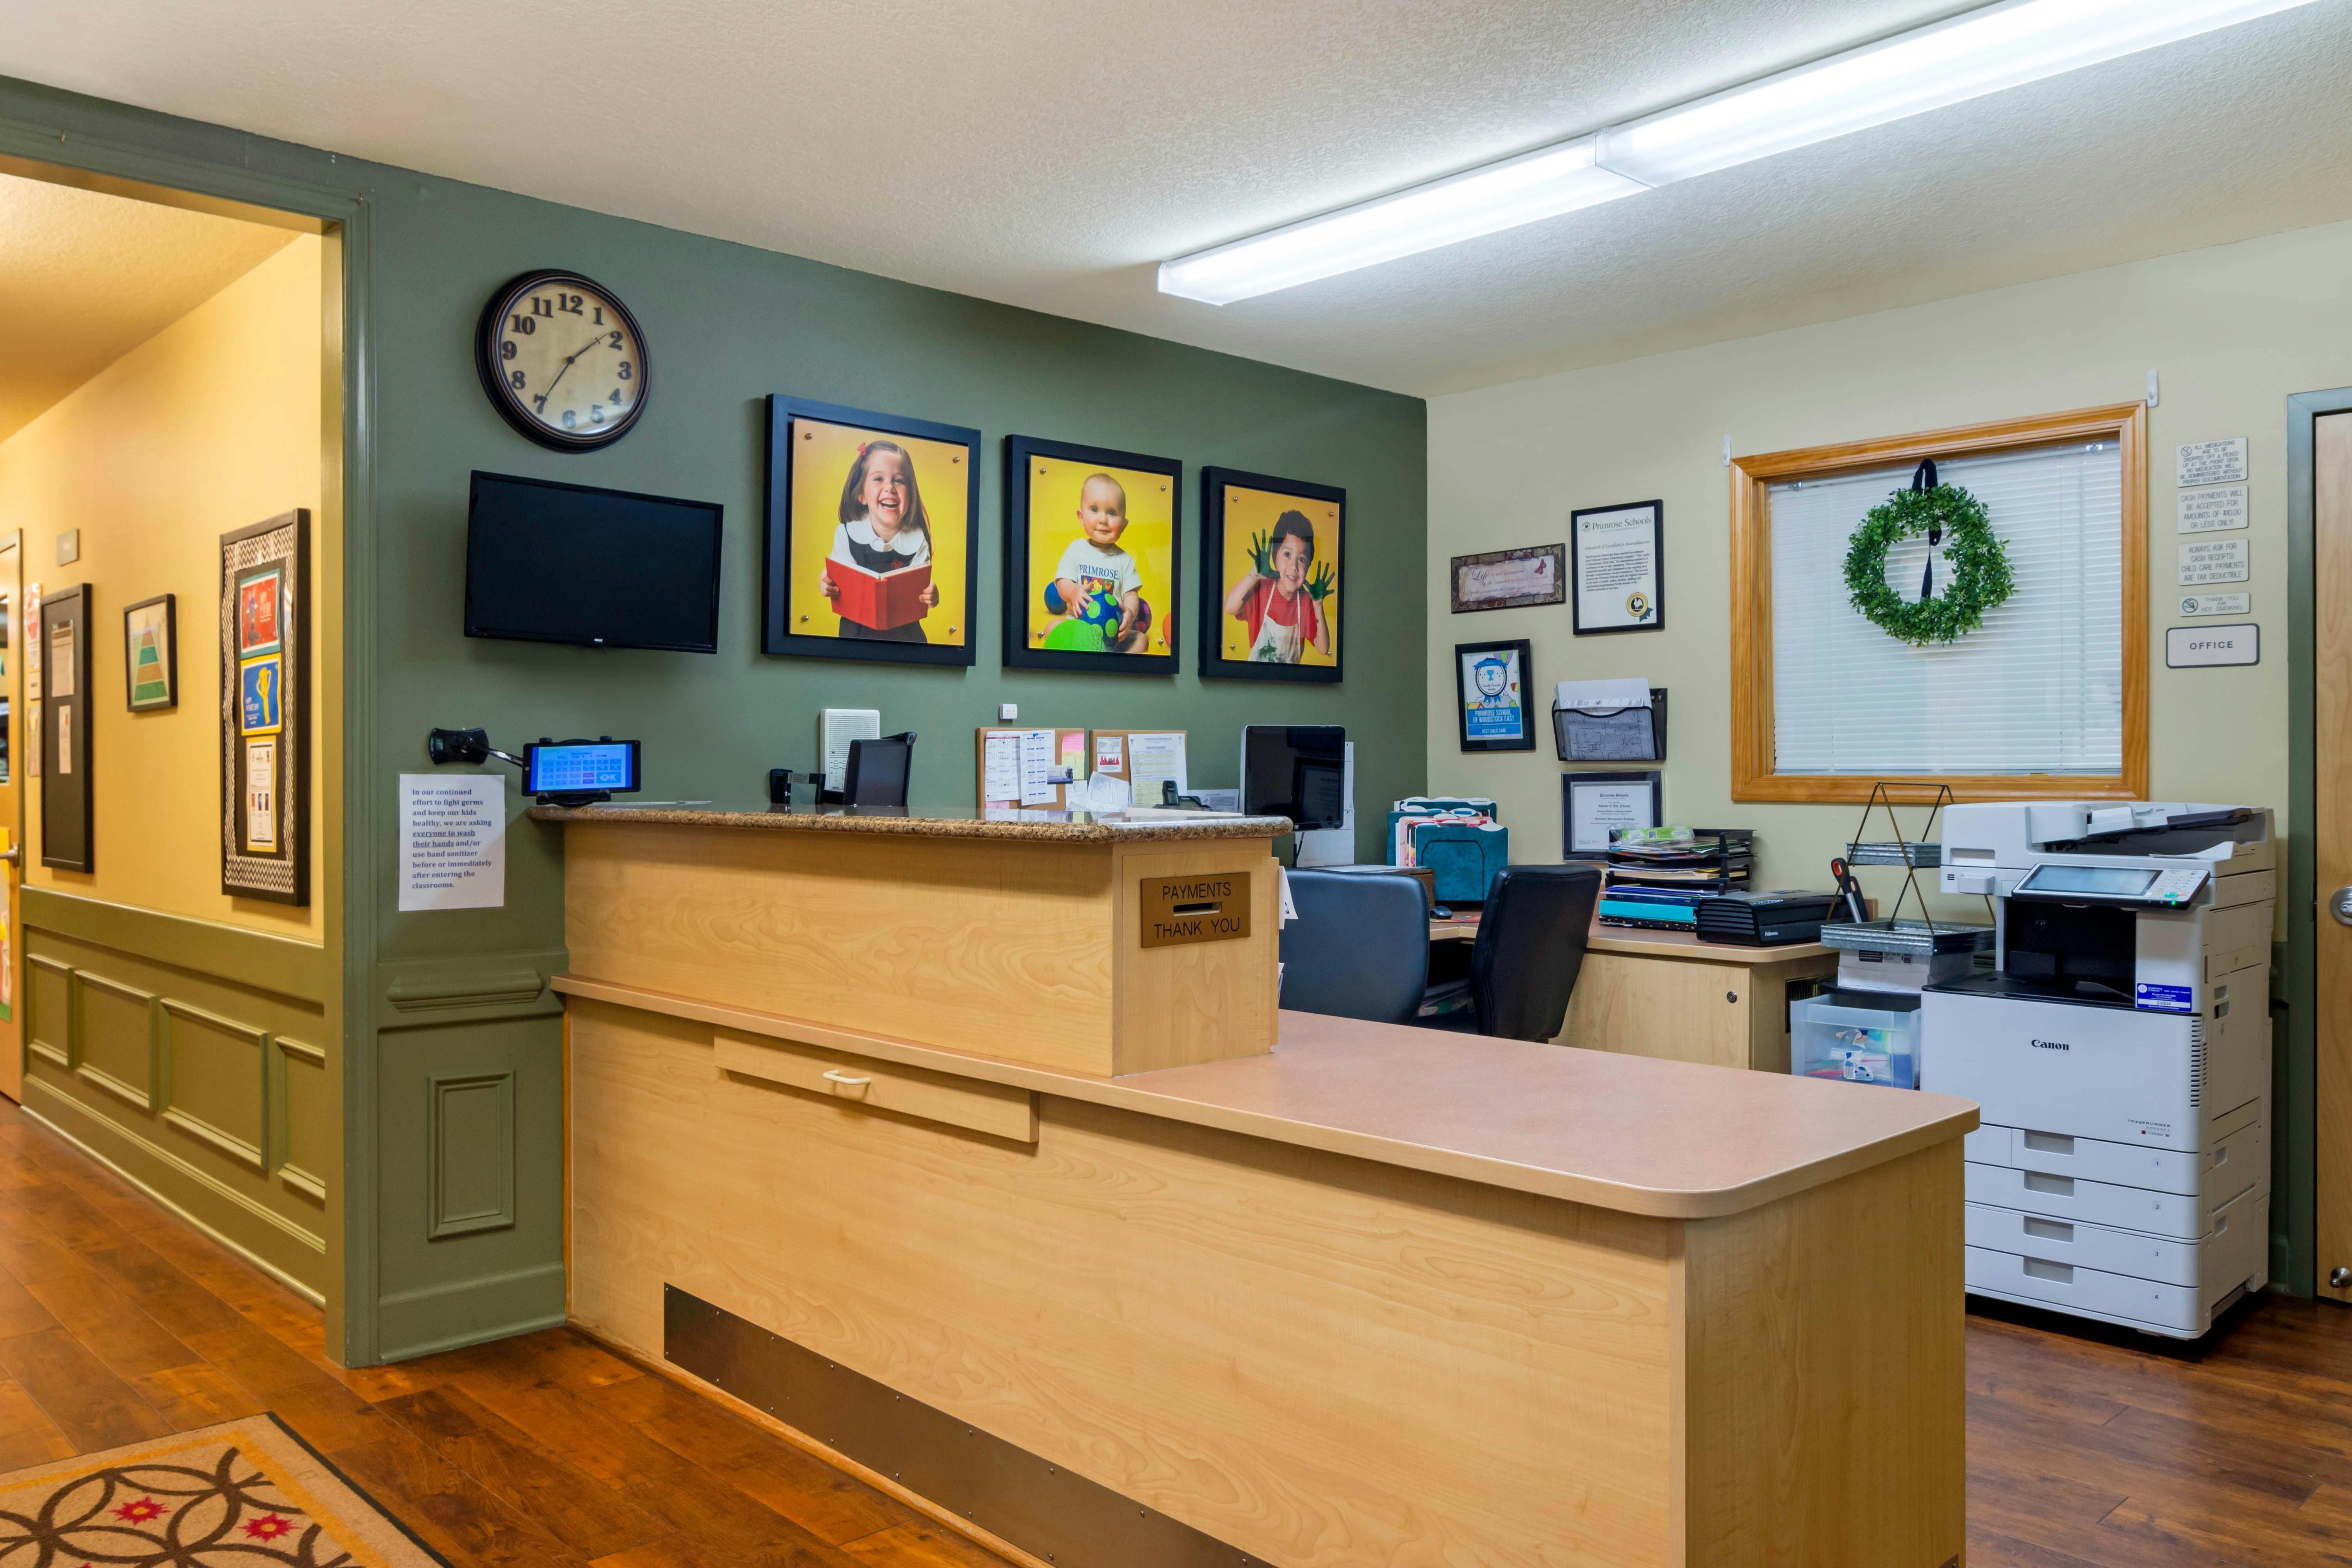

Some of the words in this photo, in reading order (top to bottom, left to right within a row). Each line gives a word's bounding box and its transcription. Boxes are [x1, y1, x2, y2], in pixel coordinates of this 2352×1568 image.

[532, 297, 554, 318] 11
[558, 294, 583, 316] 12
[512, 314, 535, 335] 10
[593, 307, 604, 326] 1
[609, 330, 623, 351] 2
[502, 341, 517, 360] 9
[512, 370, 526, 390] 8
[618, 361, 632, 380] 3
[534, 394, 548, 414] 7
[609, 388, 622, 406] 4
[563, 410, 576, 429] 6
[590, 404, 603, 423] 5
[2198, 491, 2227, 500] PAYMENTS
[2196, 501, 2224, 510] ACCEPTED
[1593, 522, 1622, 530] Primrose
[1624, 516, 1651, 526] Schools
[2183, 512, 2210, 520] AMOUNTS
[2208, 553, 2234, 561] RECEIPTS!
[2215, 561, 2245, 570] PAYMENTS
[1079, 564, 1119, 580] PRIMROSE
[1472, 568, 1487, 581] Life
[2209, 571, 2242, 580] DEDUCTIBLE
[2190, 641, 2234, 650] OFFICE
[1163, 881, 1231, 901] PAYMENTS
[1154, 921, 1202, 938] THANK
[1211, 917, 1240, 933] YOU
[2031, 1039, 2069, 1051] Canon
